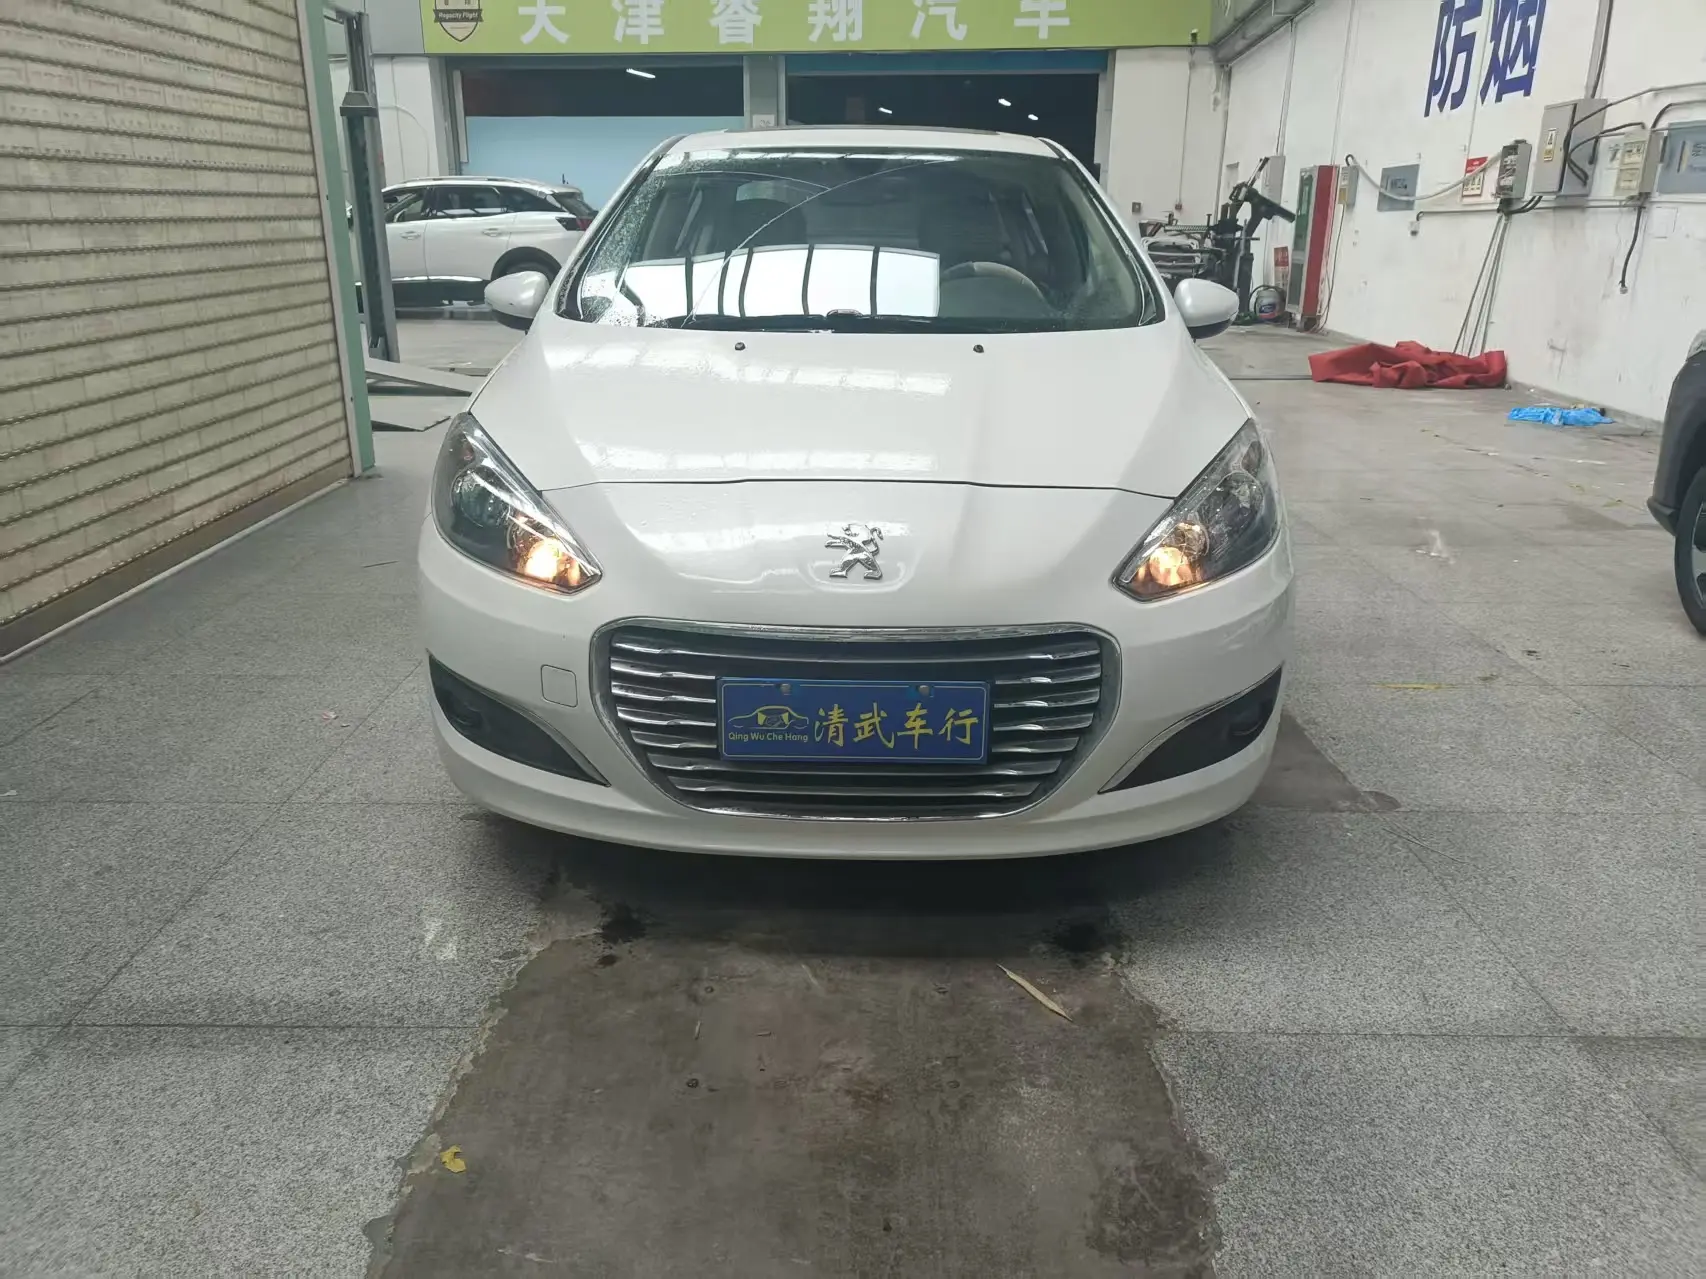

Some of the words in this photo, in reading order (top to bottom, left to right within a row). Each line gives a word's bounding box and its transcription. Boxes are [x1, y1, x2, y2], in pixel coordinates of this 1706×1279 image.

[728, 731, 749, 742] Qing
[750, 732, 765, 741] Wu
[766, 732, 783, 741] Che
[785, 732, 809, 743] Hang
[814, 702, 979, 750] 清武车行
